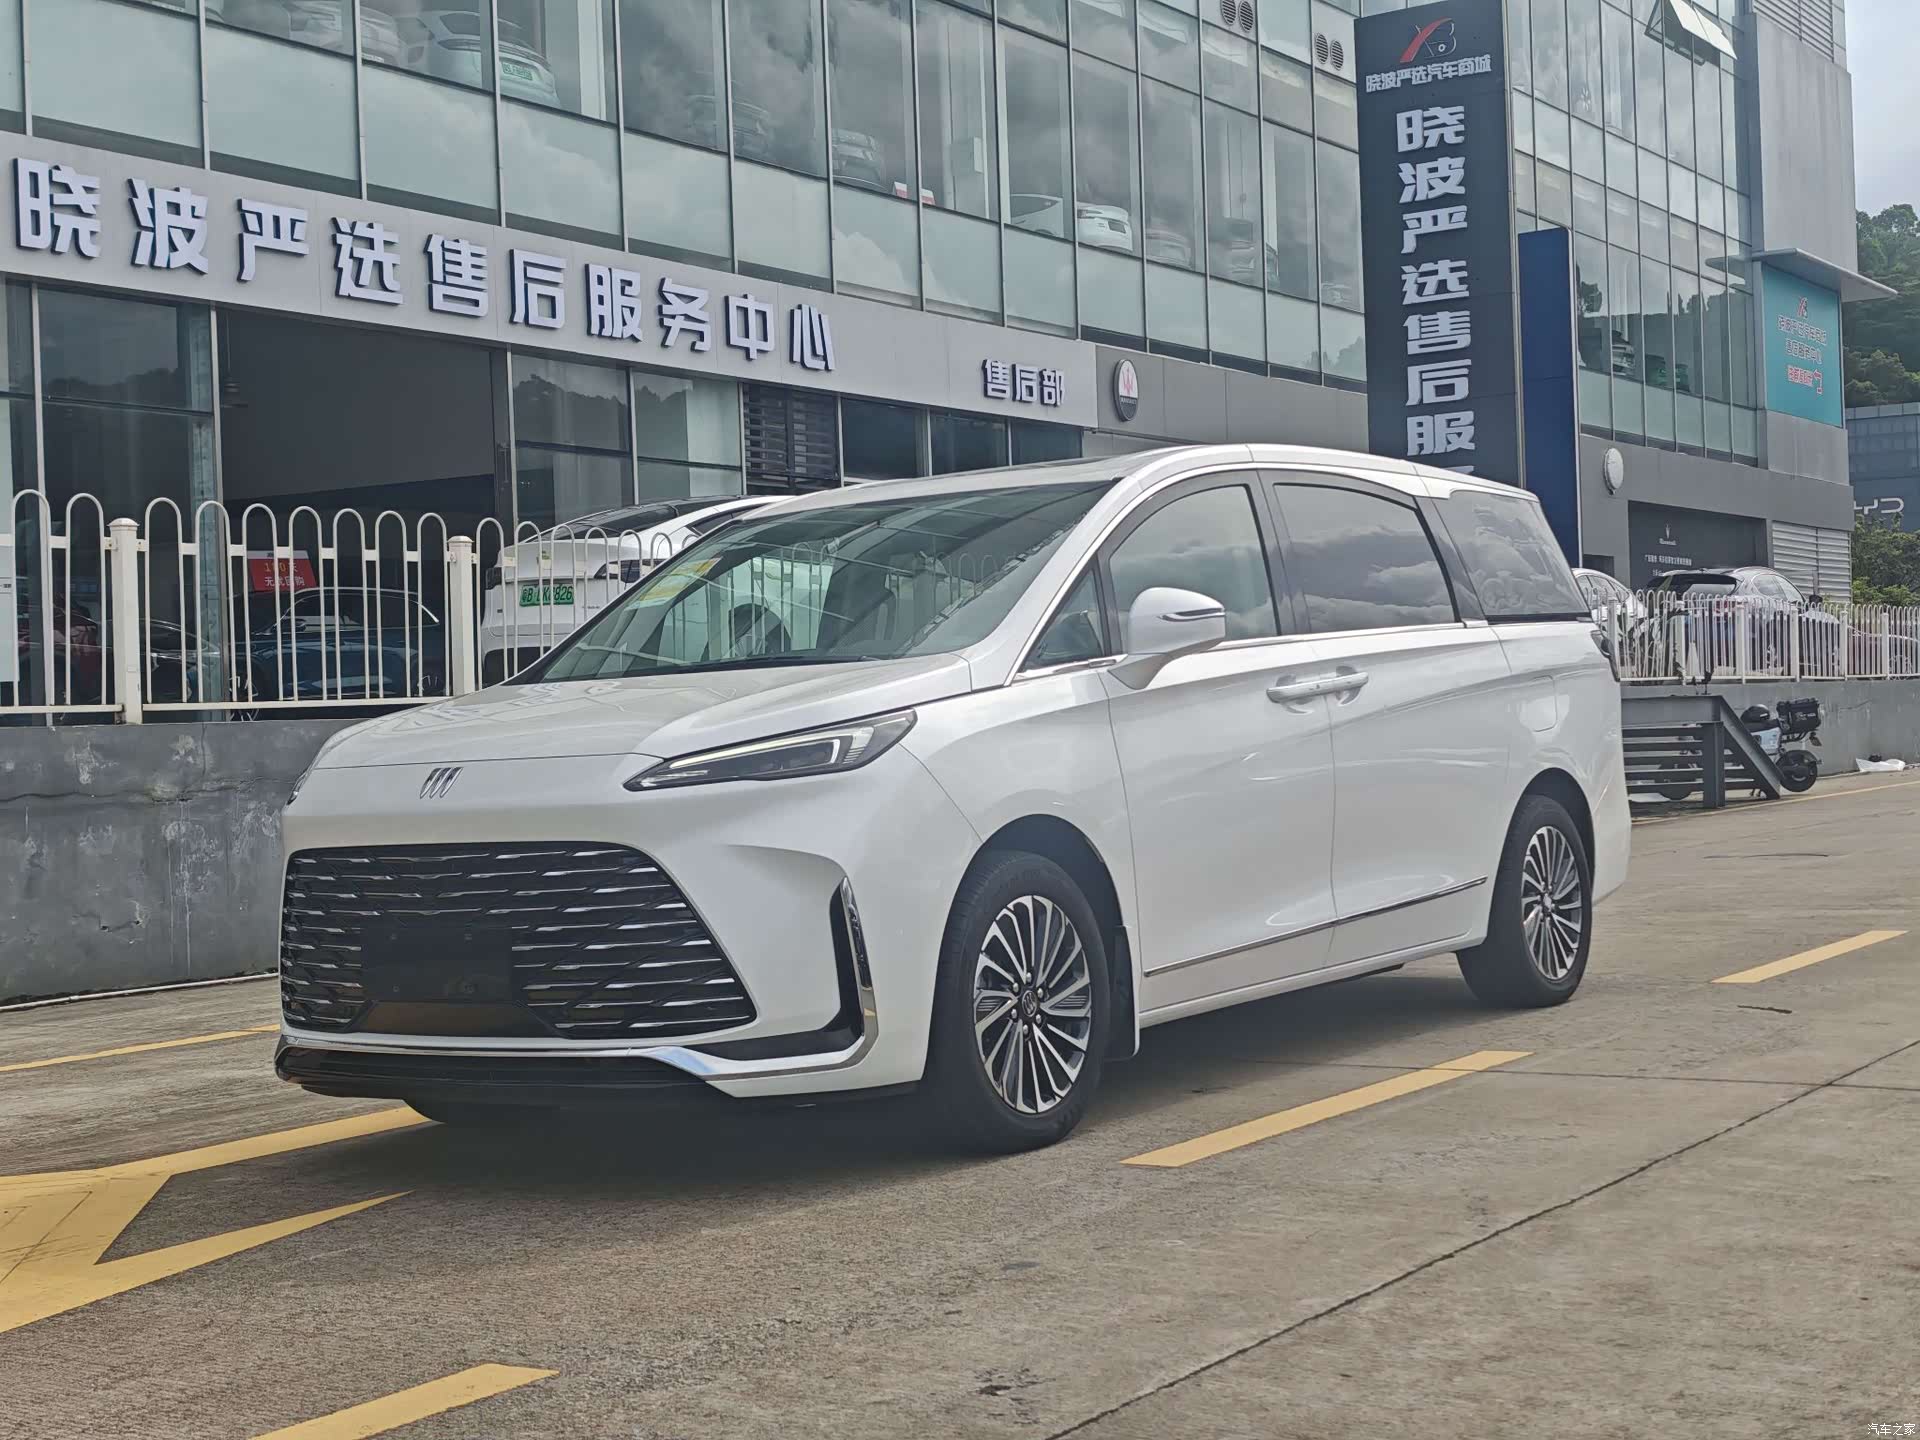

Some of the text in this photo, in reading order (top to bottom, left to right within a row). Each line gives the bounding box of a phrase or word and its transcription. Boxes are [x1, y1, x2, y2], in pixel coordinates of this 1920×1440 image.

[1366, 54, 1492, 93] 晓波严选汽车商城
[13, 157, 836, 371] 晓波严选售后服务中心
[1396, 105, 1475, 474] 晓波严选售后服
[981, 359, 1065, 407] 售后部
[1853, 497, 1905, 515] YD
